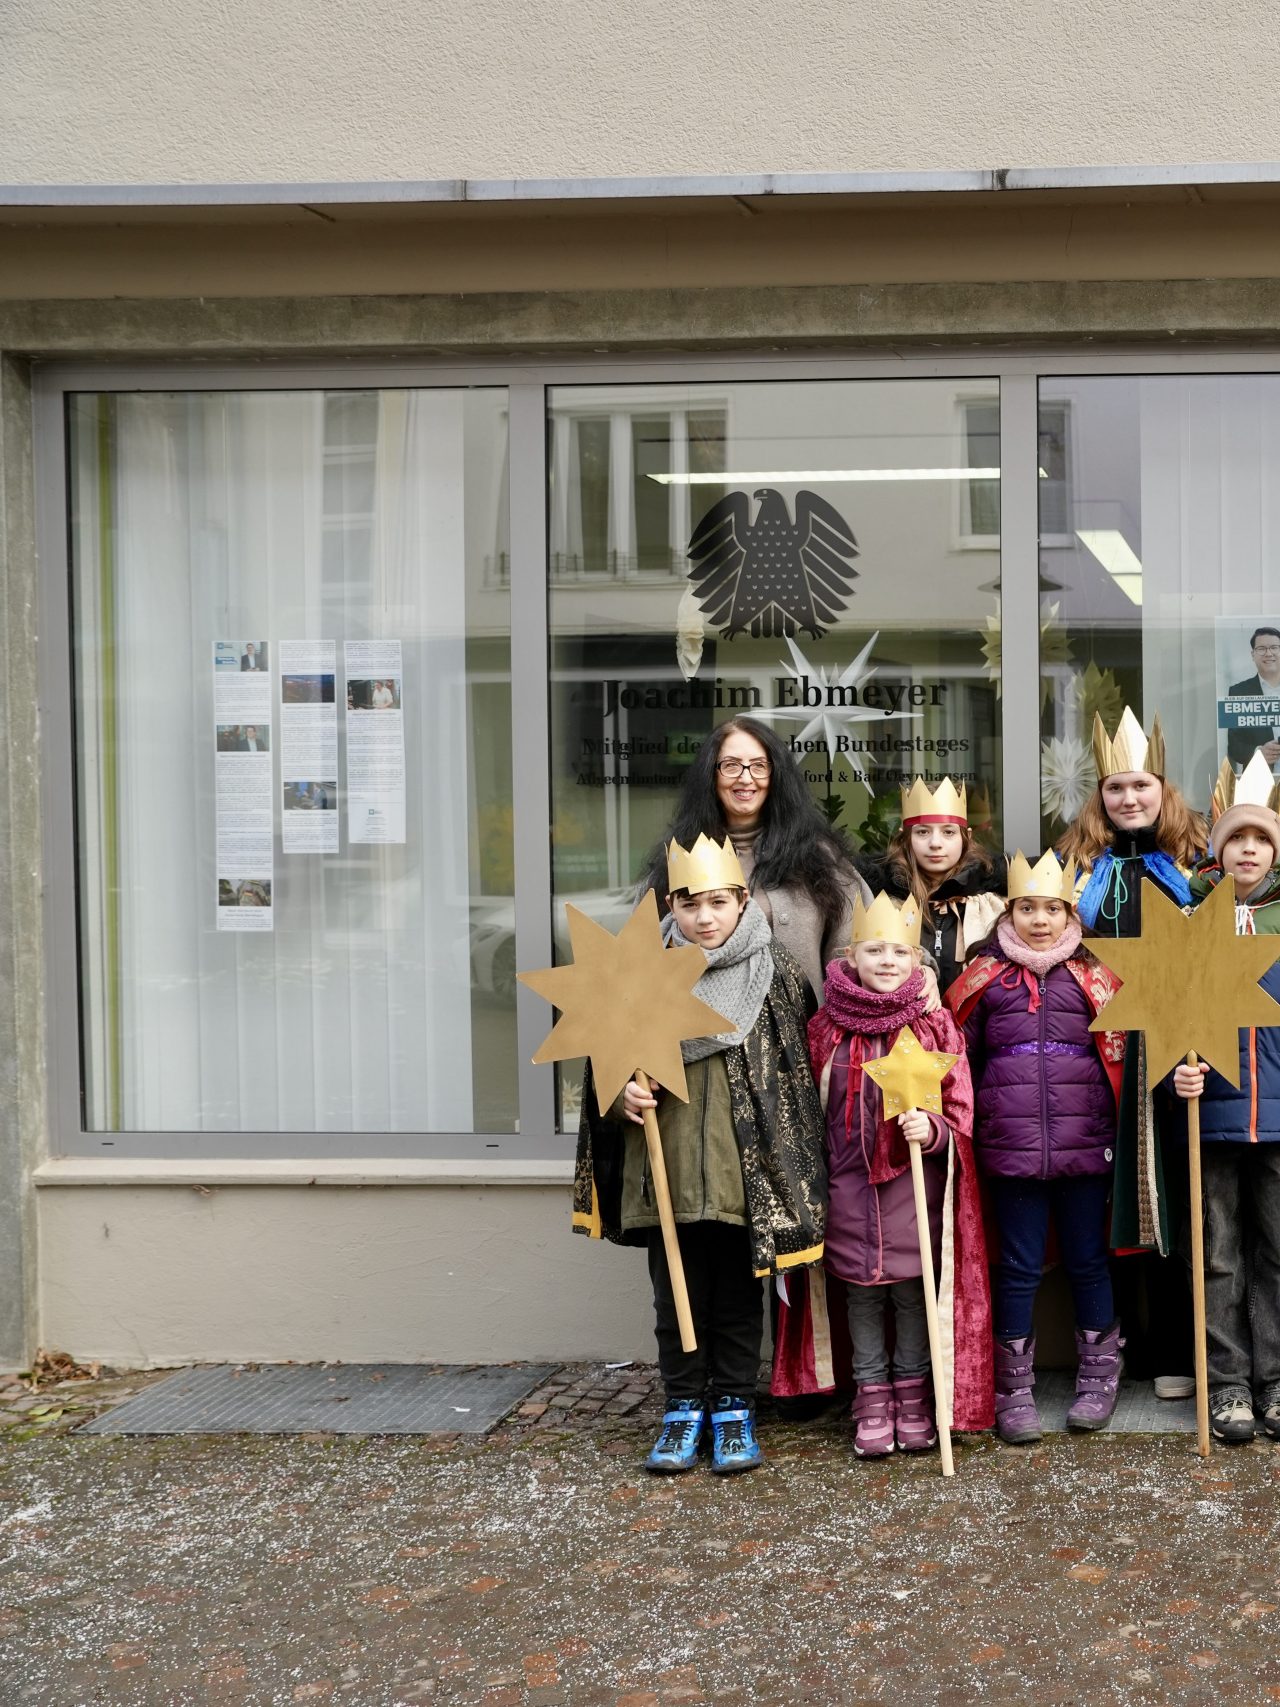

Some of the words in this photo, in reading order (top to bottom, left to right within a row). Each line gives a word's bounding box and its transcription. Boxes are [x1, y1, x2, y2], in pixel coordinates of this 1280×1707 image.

[603, 677, 763, 718] Joachim
[775, 675, 948, 717] Ebmeyer
[582, 736, 669, 760] Mitglied
[836, 734, 969, 757] Bundestages
[838, 771, 849, 783] &
[853, 769, 882, 784] Bad
